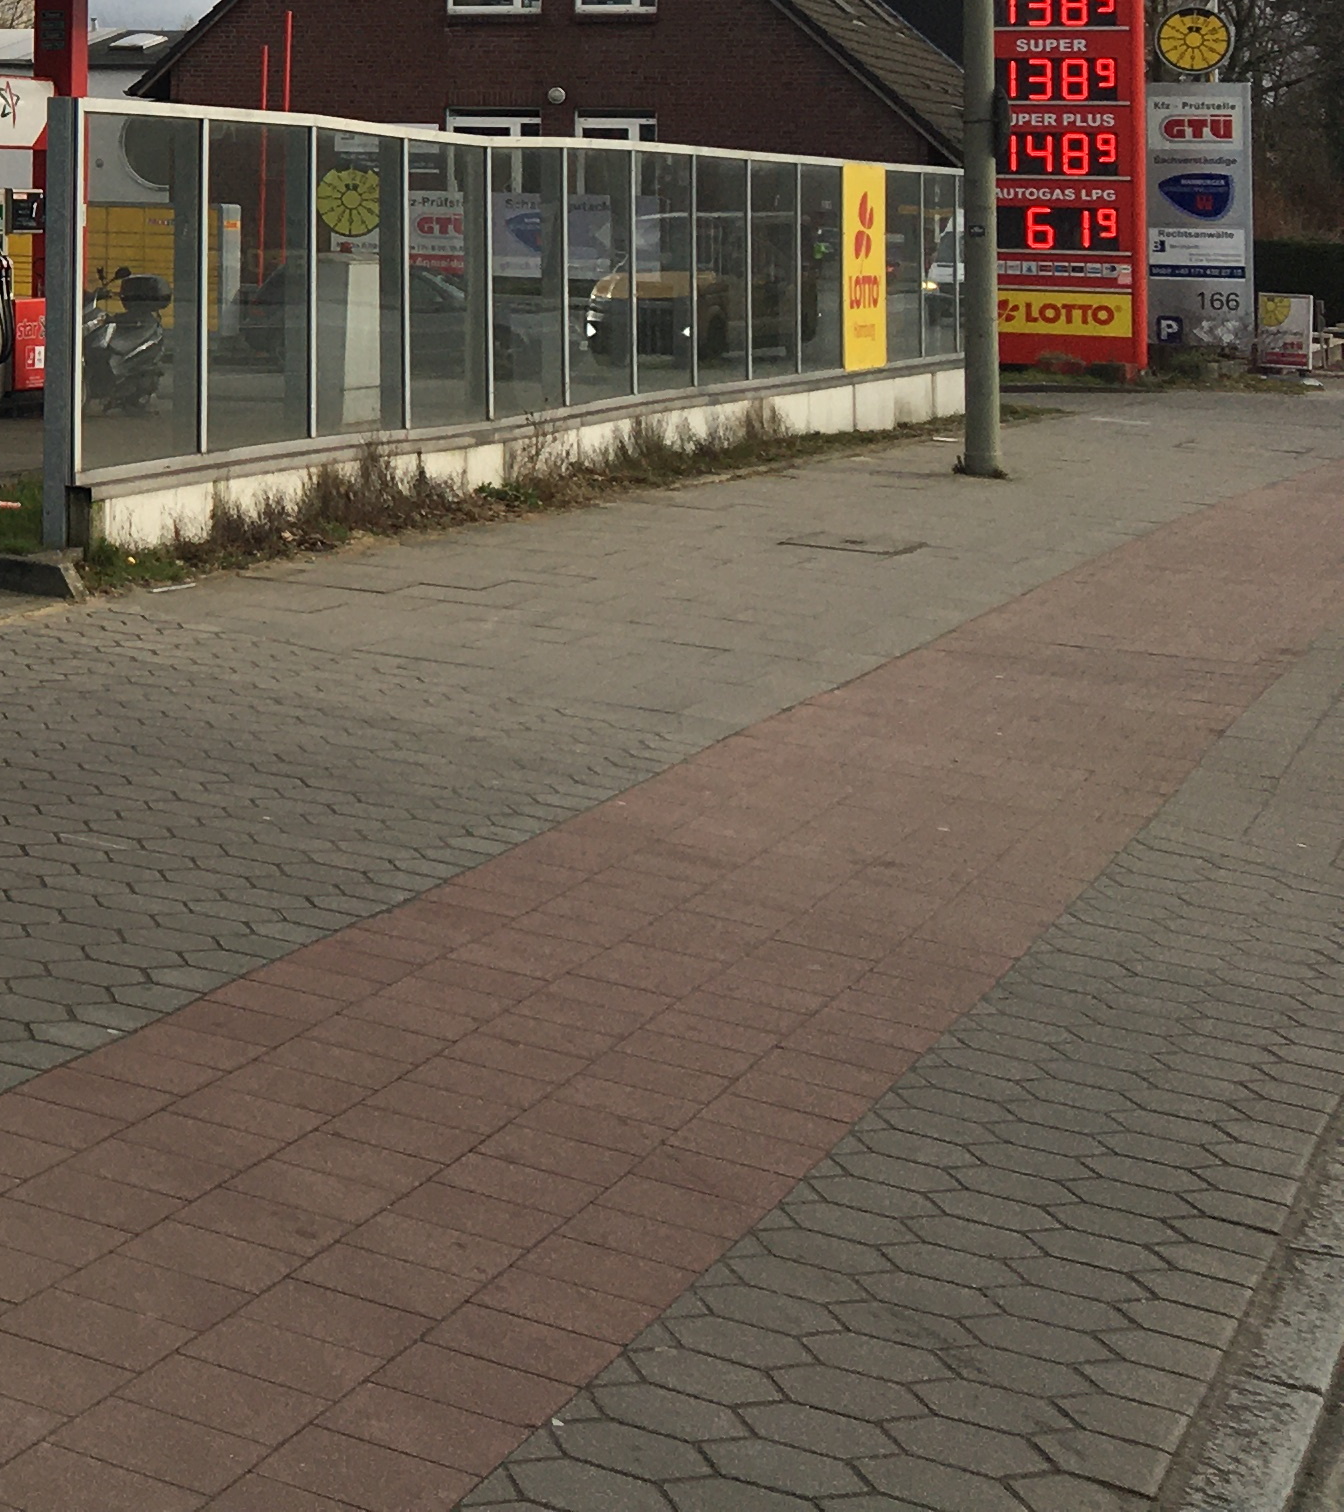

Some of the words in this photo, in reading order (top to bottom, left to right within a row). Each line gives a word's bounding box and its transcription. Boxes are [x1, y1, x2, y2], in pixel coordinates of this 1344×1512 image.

[1016, 39, 1087, 52] SUPER
[1153, 102, 1170, 110] Kfz
[1181, 101, 1237, 110] Prüfstelle
[1010, 114, 1056, 126] PER
[1063, 114, 1115, 126] PLUS
[1163, 114, 1233, 139] GTÜ
[996, 188, 1075, 200] AUTOGAS
[1081, 189, 1116, 201] LPG
[849, 275, 879, 309] LOTTO
[1197, 292, 1240, 310] 166
[1024, 302, 1115, 325] LOTTO
[16, 320, 39, 340] star
